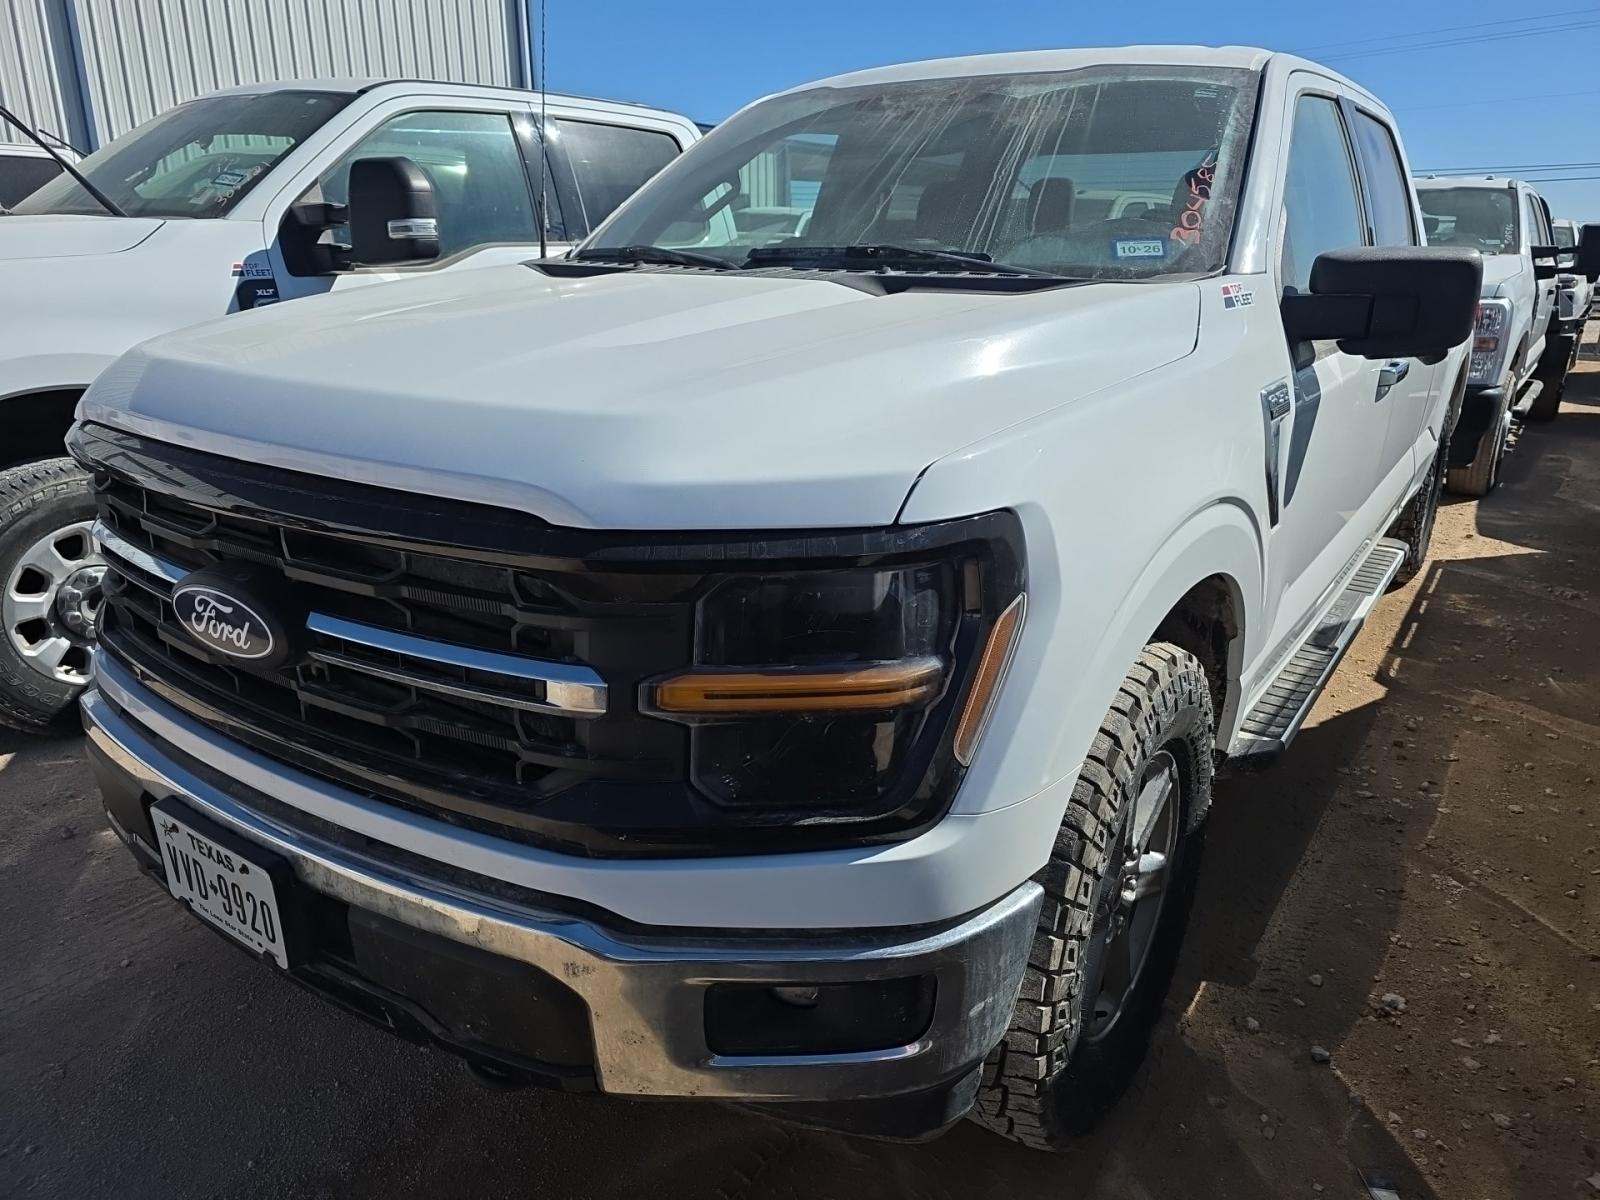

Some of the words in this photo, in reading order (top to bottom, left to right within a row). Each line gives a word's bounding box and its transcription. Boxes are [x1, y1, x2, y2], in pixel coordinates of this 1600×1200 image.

[246, 269, 272, 277] FLEET
[256, 288, 275, 296] XLT
[1235, 293, 1254, 305] FLEET
[191, 595, 251, 650] Ford
[186, 832, 235, 873] TEXAS
